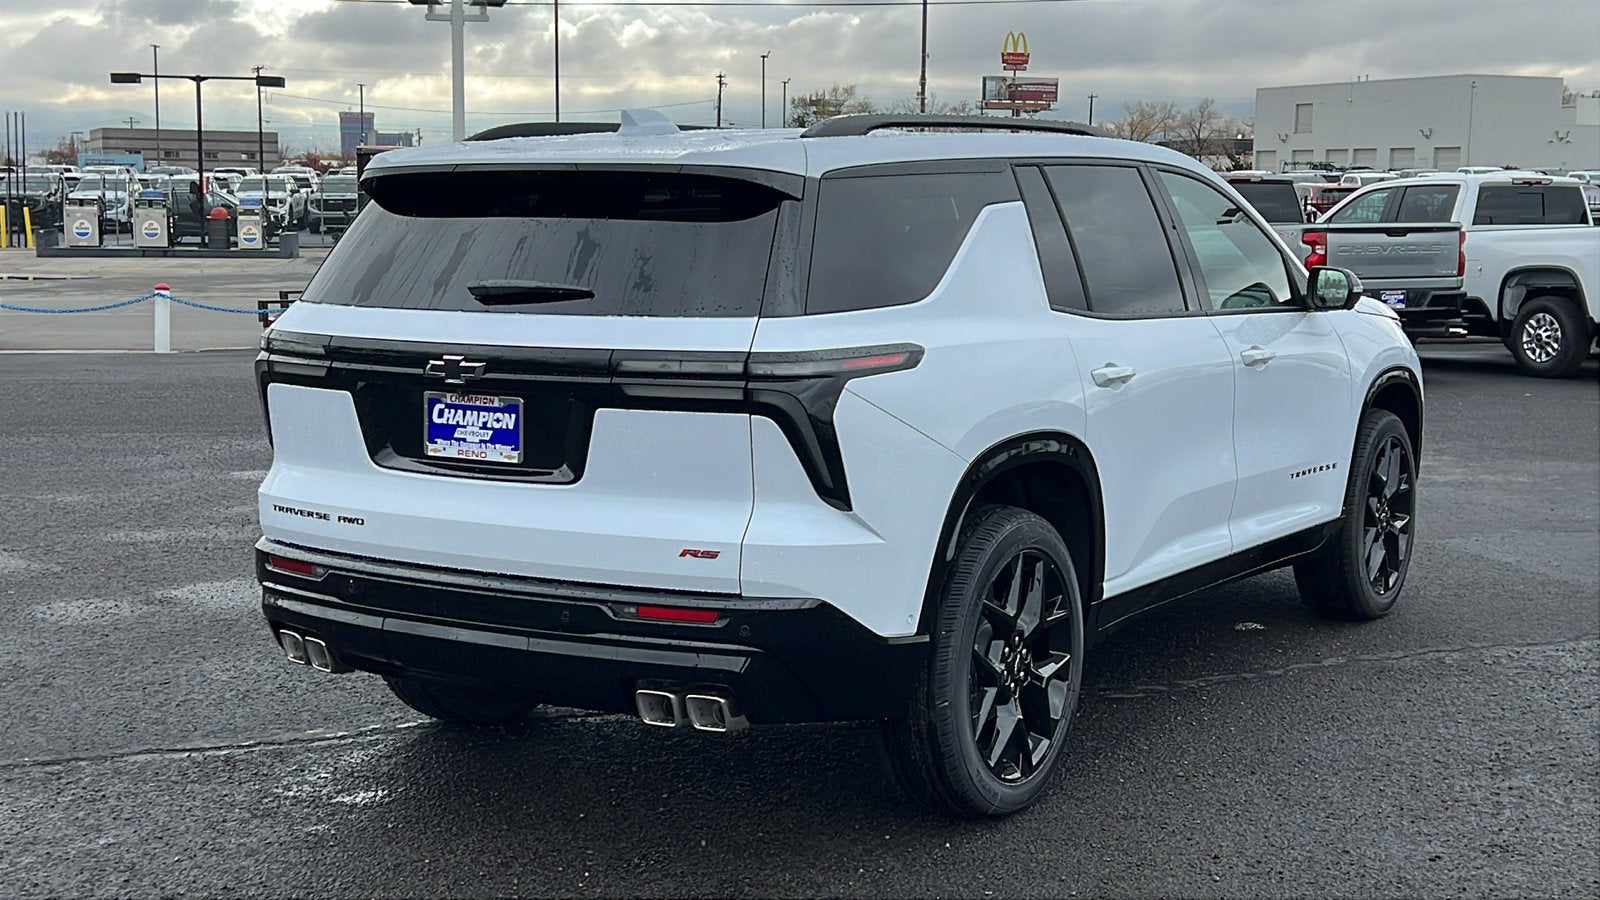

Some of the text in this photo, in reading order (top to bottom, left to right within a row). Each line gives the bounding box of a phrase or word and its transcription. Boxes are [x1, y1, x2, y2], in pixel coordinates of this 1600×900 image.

[1337, 244, 1453, 255] CHEVROLET
[449, 394, 495, 405] CHAMPION
[432, 403, 516, 429] CHAMPION
[456, 429, 490, 438] CHEVROLET
[457, 449, 487, 458] RENO
[1290, 463, 1337, 479] TRAVERSE
[272, 504, 365, 526] TRAVERSE AWD
[678, 549, 721, 559] RS
